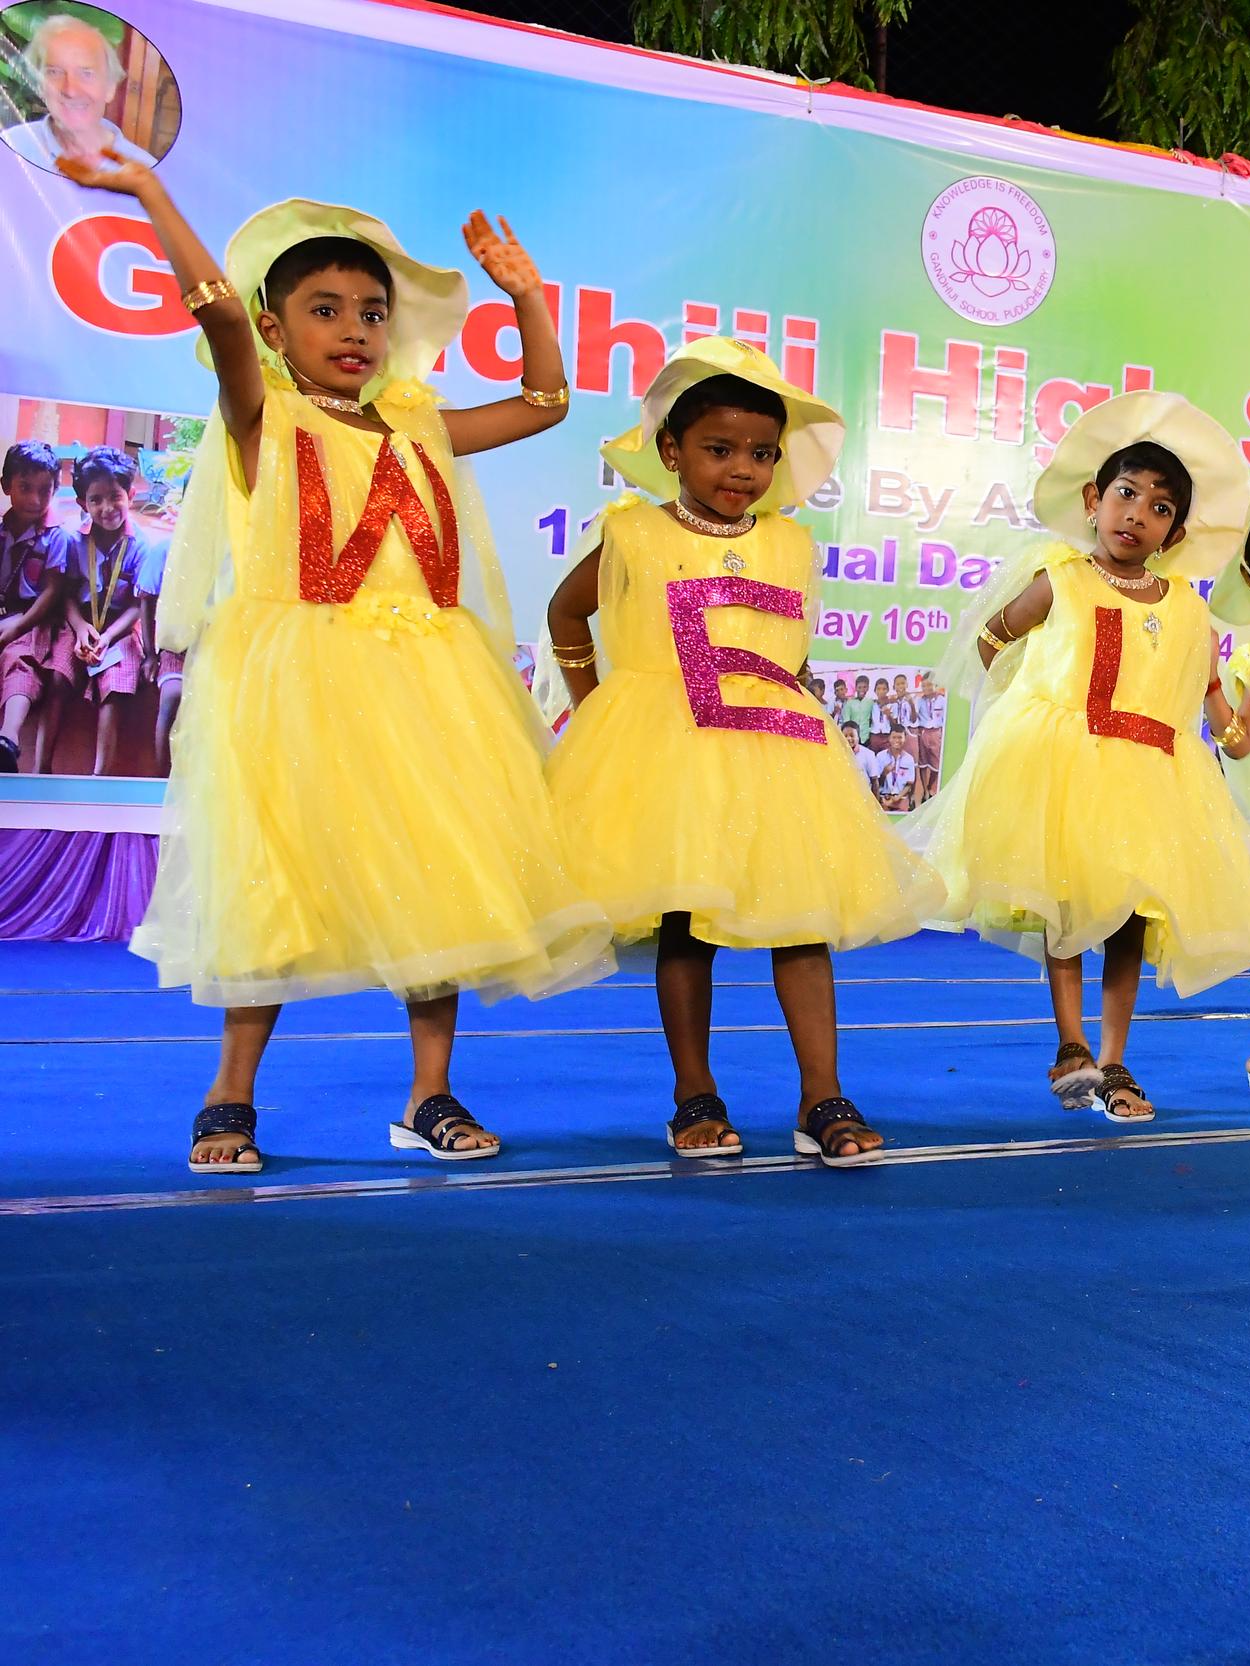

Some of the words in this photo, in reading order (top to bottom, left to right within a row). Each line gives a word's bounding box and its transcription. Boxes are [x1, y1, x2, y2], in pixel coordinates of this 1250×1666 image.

[931, 178, 993, 219] KNOWLEDGE
[995, 179, 1006, 193] IS
[1007, 186, 1048, 236] FREEDOM
[930, 252, 958, 301] GANDHIJI
[959, 300, 1000, 321] SCHOOL
[294, 426, 460, 608] W
[868, 468, 956, 530] By
[883, 607, 949, 643] 16th
[666, 575, 828, 746] E
[1086, 606, 1175, 757] L
